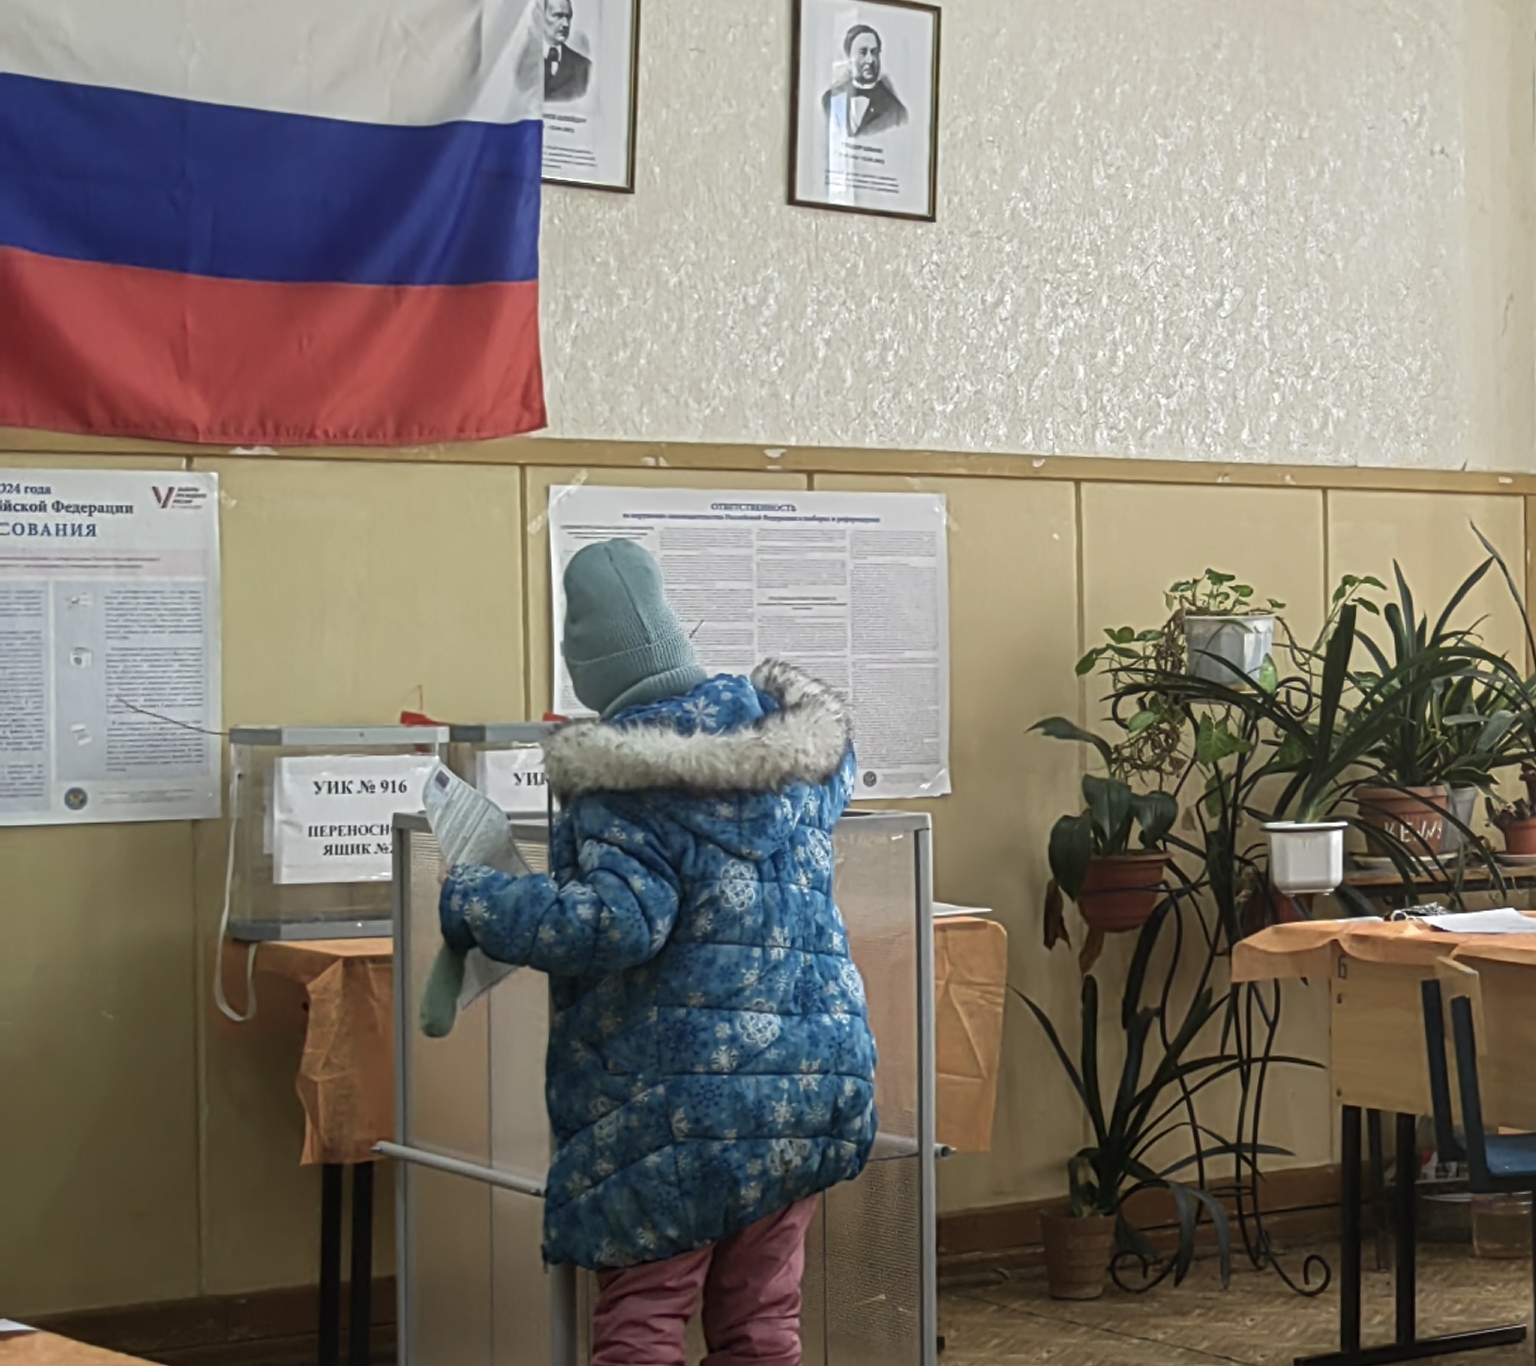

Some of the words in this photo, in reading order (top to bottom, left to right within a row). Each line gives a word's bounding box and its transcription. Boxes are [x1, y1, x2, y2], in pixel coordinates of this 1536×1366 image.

[24, 486, 51, 495] года
[51, 500, 134, 517] Федерации
[312, 780, 354, 795] УИК
[356, 779, 376, 794] №
[380, 779, 408, 794] 916
[308, 824, 392, 838] ПЕРЕНОСН
[323, 843, 371, 857] ЯЩИК
